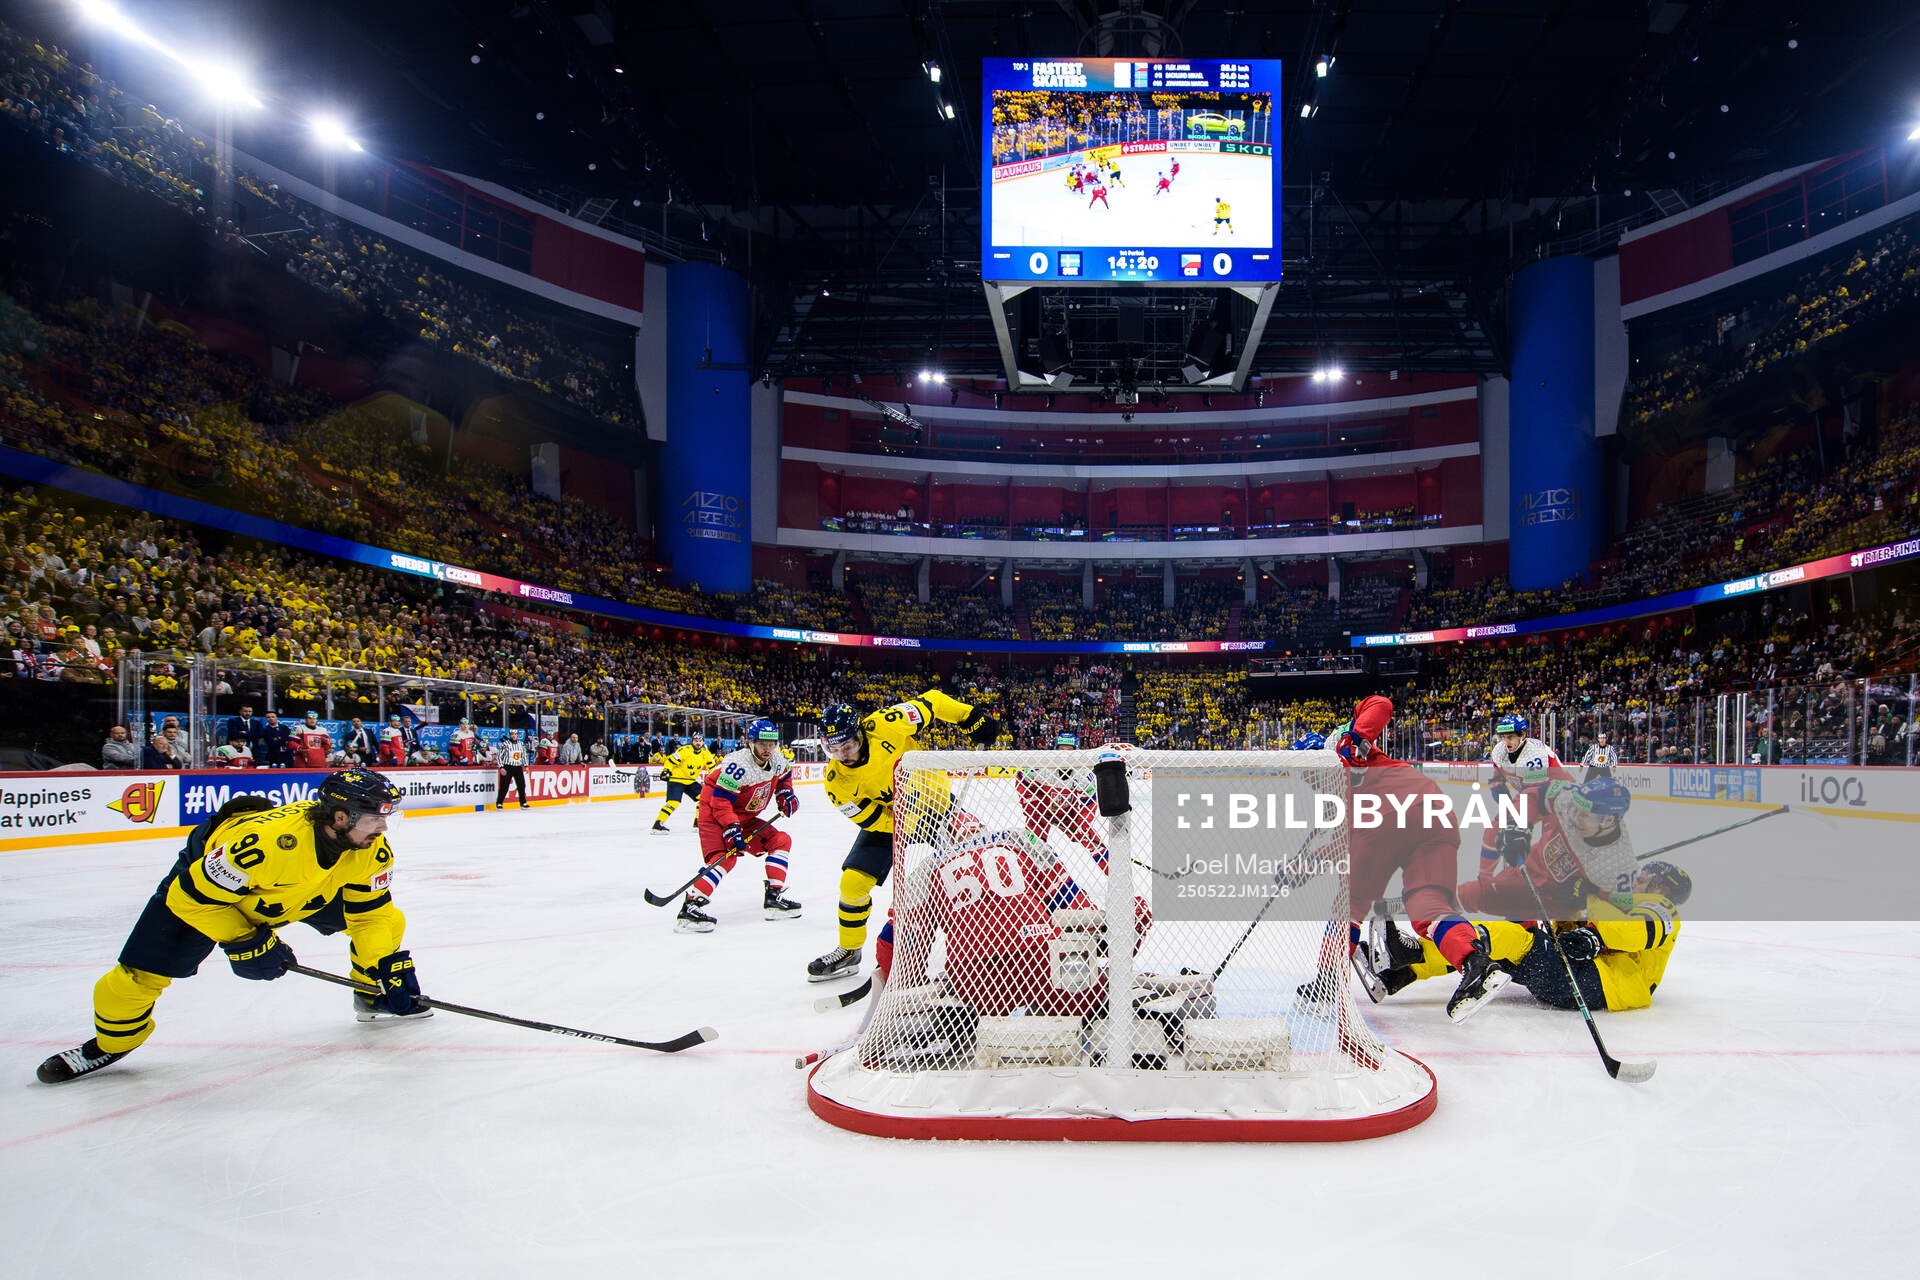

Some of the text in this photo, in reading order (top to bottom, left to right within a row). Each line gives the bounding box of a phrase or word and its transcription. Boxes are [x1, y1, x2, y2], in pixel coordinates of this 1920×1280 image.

[1032, 62, 1083, 75] FASTEST
[1032, 75, 1087, 88] SKATERS
[1129, 143, 1166, 152] STRAUSS
[995, 162, 1042, 180] BAUHAUS
[1029, 252, 1048, 275] 0
[1108, 256, 1159, 270] 14:20
[1213, 252, 1232, 275] 0
[390, 554, 431, 574] SWEDEN
[446, 567, 482, 586] CZECHIA
[1723, 578, 1755, 595] SWEDEN
[1769, 566, 1805, 585] CZECHIA
[773, 629, 800, 639] SWEDEN
[811, 632, 839, 643] CZECHIA
[1365, 635, 1394, 645] SWEDEN
[1405, 632, 1434, 642] CZECHIA
[1123, 643, 1149, 651] SWEDEN
[1161, 643, 1188, 651] CZECHIA
[881, 740, 896, 754] A
[725, 762, 746, 781] 88
[1526, 757, 1543, 771] 23
[605, 773, 631, 785] TISSOT
[1672, 768, 1711, 793] NOCCO
[1800, 772, 1868, 807] iLOQ
[1, 813, 23, 827] at
[229, 833, 266, 870] 90
[214, 859, 243, 884] SVENSKA
[941, 846, 1027, 912] 50
